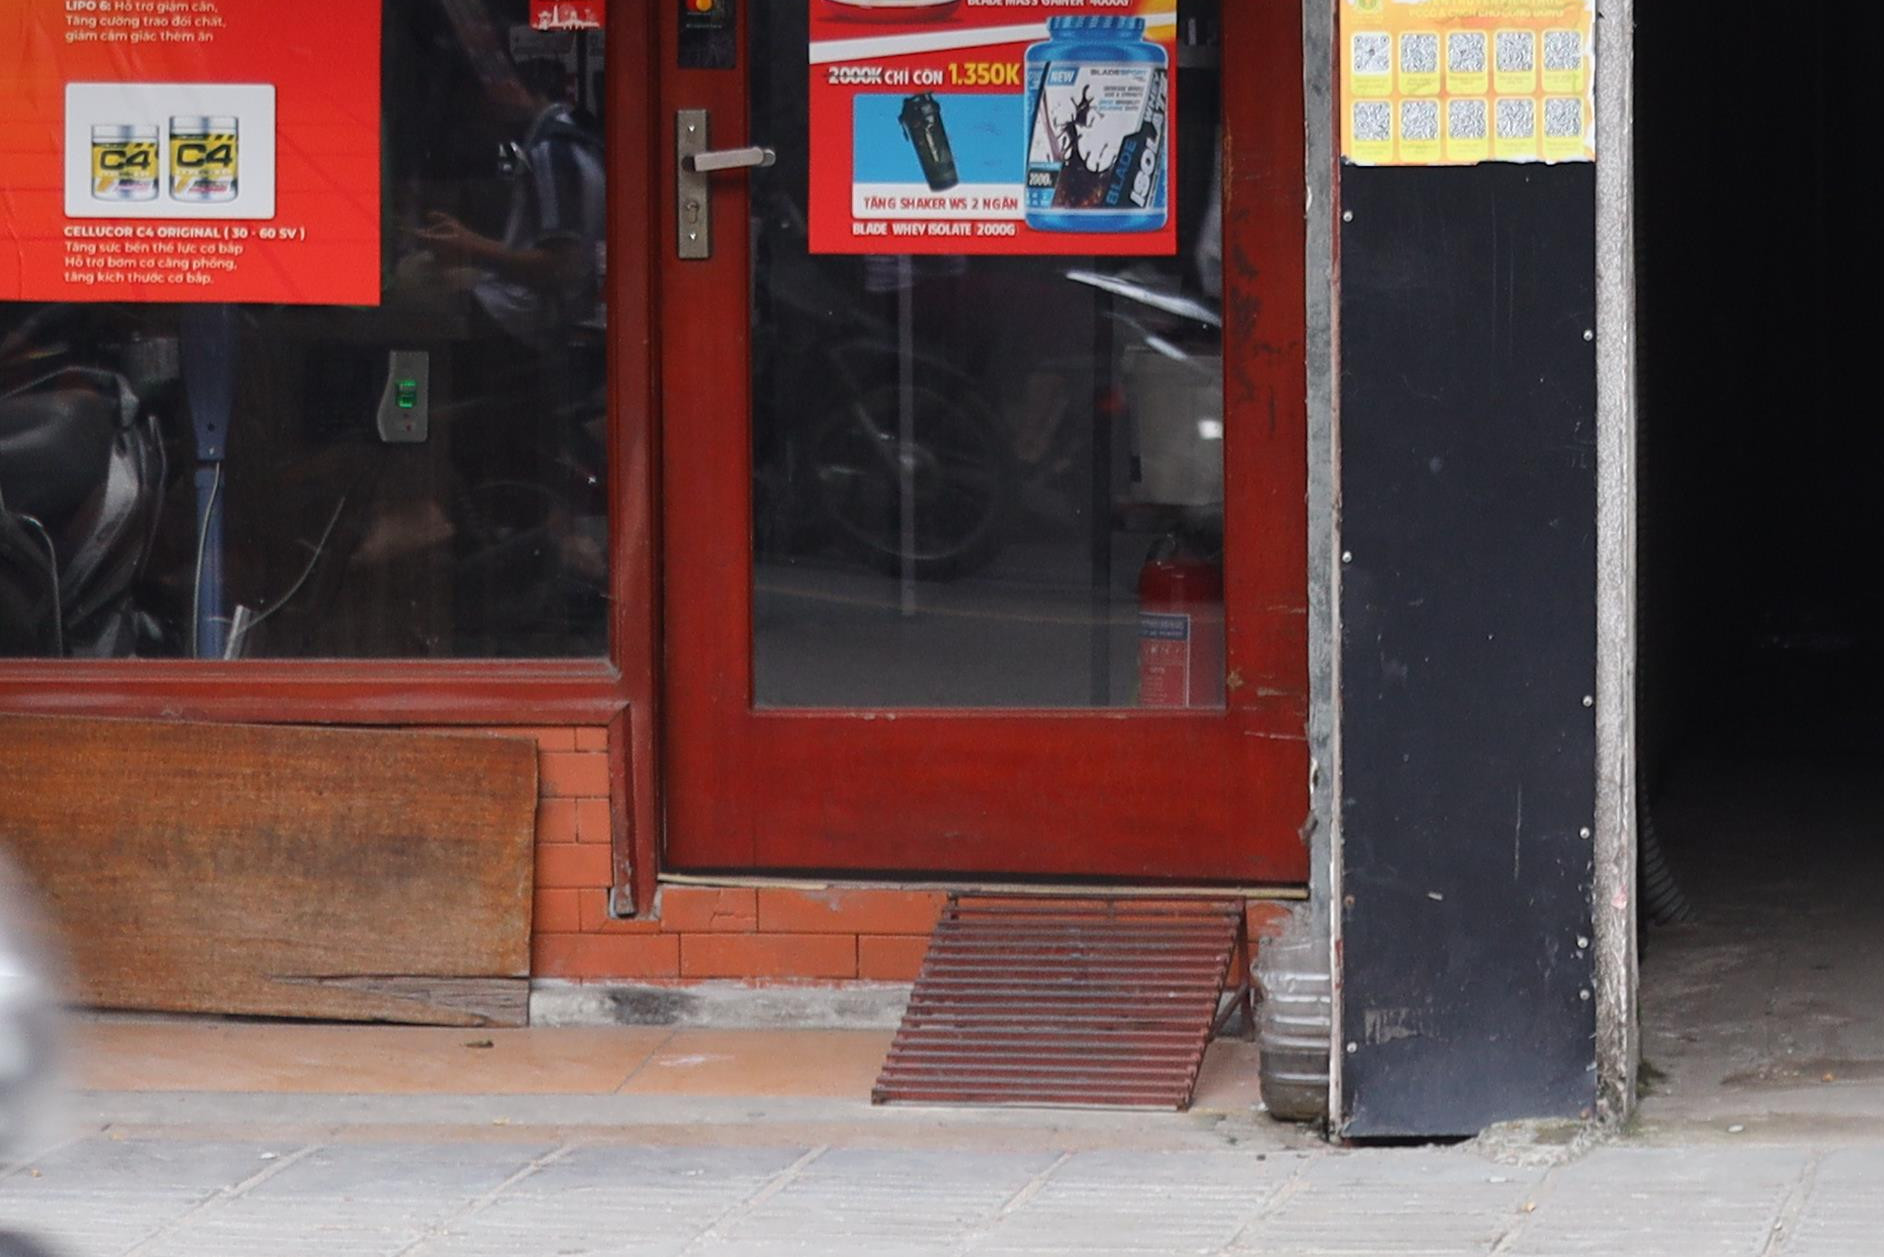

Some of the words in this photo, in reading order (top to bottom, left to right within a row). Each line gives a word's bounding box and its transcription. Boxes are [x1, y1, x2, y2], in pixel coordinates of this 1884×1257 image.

[65, 0, 97, 11] LIPO
[949, 63, 1021, 86] 1.350K
[100, 150, 151, 170] C4
[176, 143, 233, 168] C4
[900, 198, 946, 211] SHAKER
[949, 198, 967, 210] WS
[971, 199, 978, 210] 2
[64, 226, 133, 237] CELLUCOR
[136, 226, 154, 237] C4
[157, 226, 221, 238] ORIGINAL
[259, 228, 276, 239] 60
[853, 223, 888, 236] BLADE
[928, 223, 972, 236] ISOLATE
[977, 224, 1016, 236] 2000G
